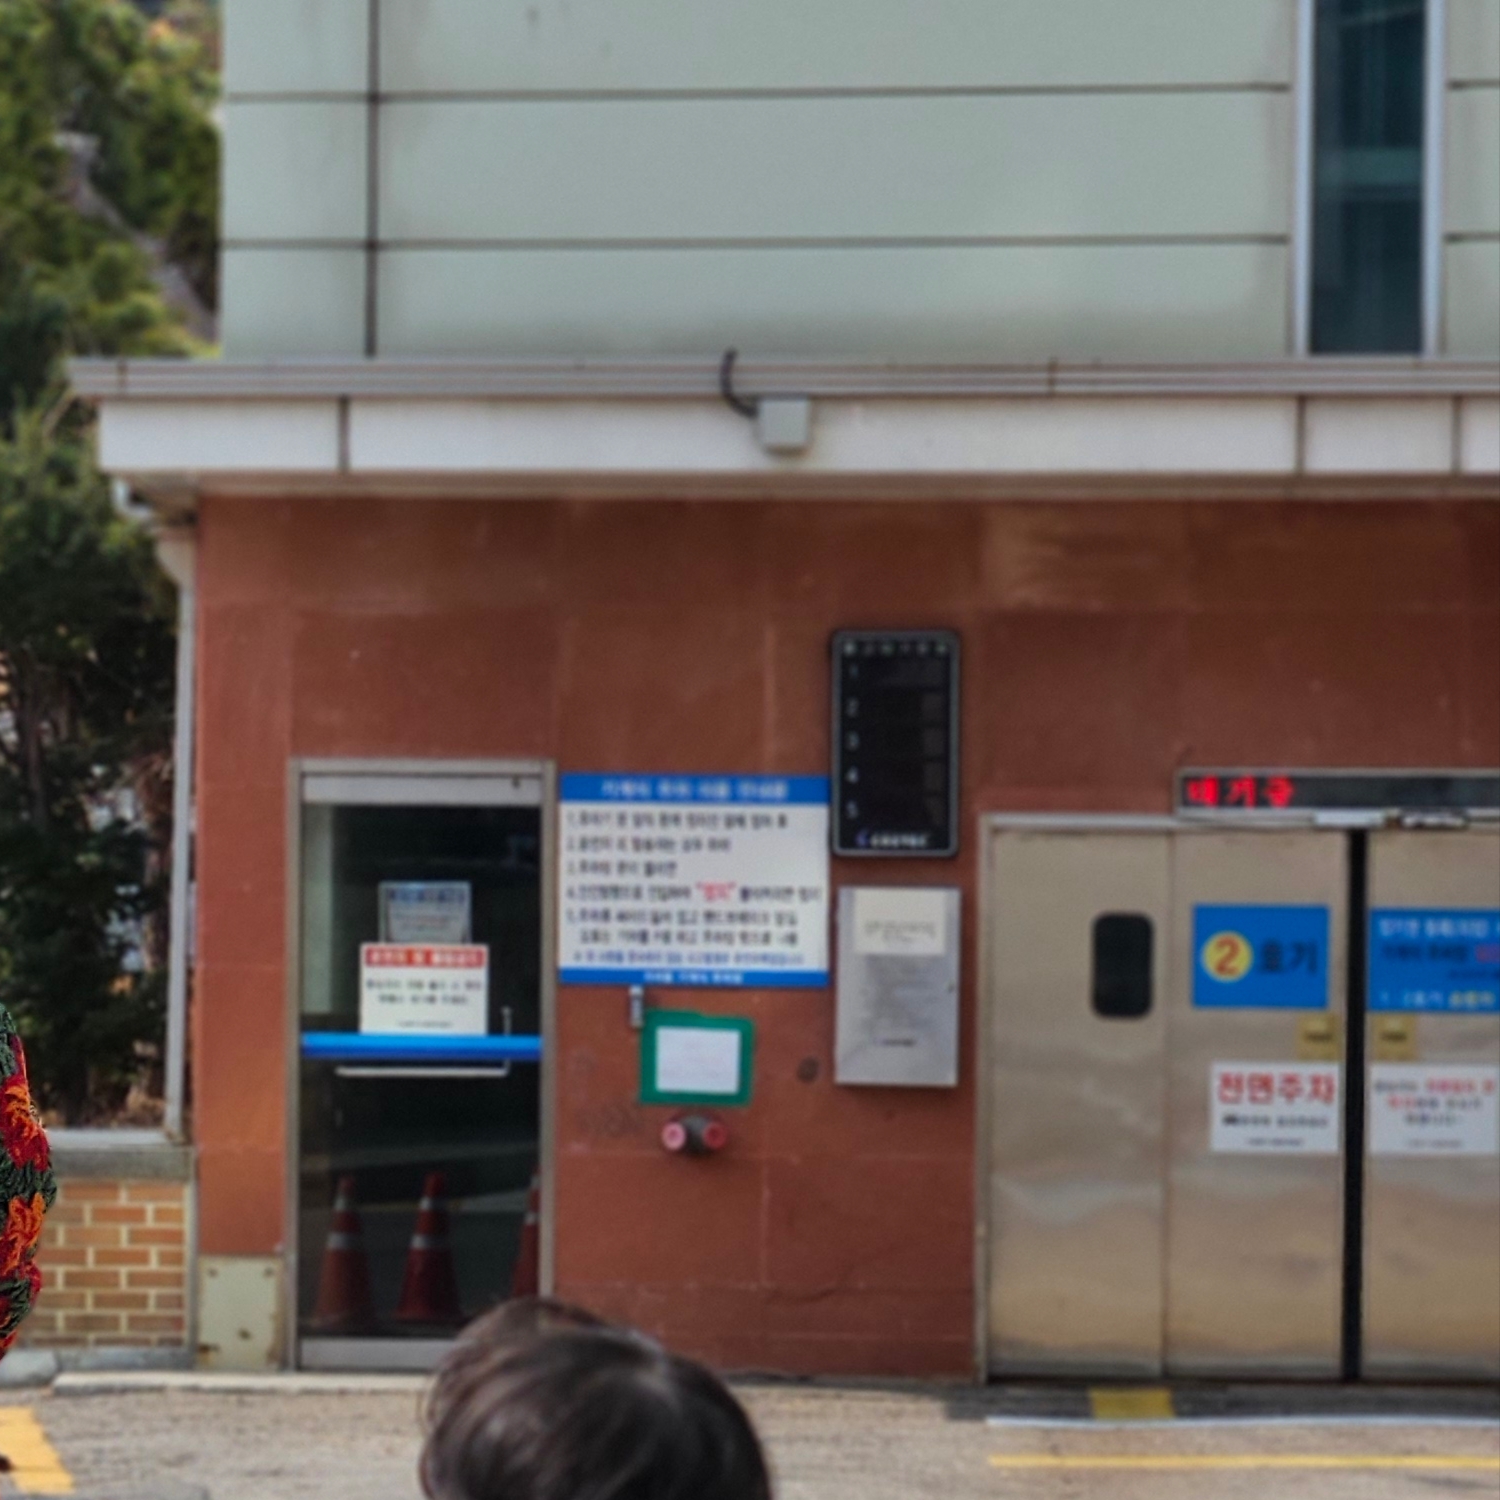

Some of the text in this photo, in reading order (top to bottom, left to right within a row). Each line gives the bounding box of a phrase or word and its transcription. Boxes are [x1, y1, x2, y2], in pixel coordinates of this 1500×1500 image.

[1215, 935, 1319, 976] 2 호기
[1216, 1072, 1337, 1106] 전면주차
